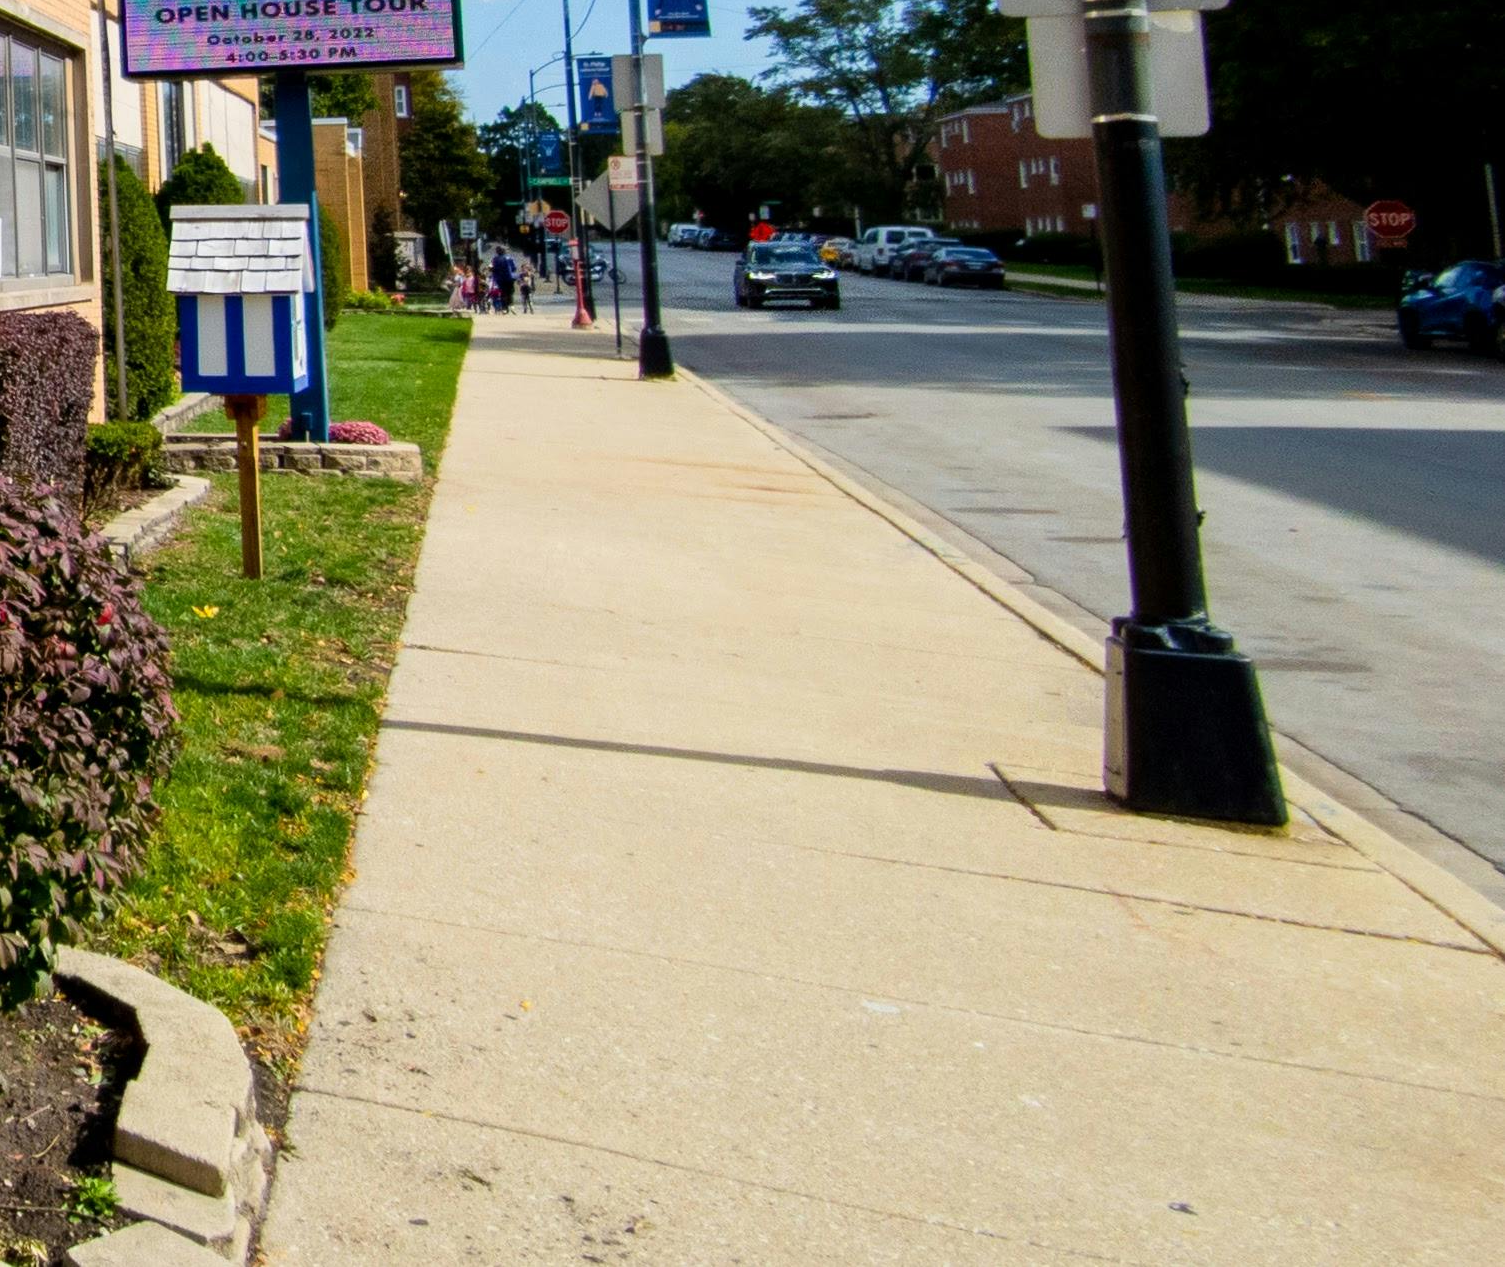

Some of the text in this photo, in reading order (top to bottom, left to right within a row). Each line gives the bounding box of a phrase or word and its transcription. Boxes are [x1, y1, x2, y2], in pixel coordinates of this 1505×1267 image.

[155, 4, 230, 24] OPEN
[207, 32, 284, 46] October
[329, 27, 375, 39] 2022
[328, 46, 357, 59] PM
[545, 217, 568, 227] STOP
[1368, 212, 1410, 226] STOP
